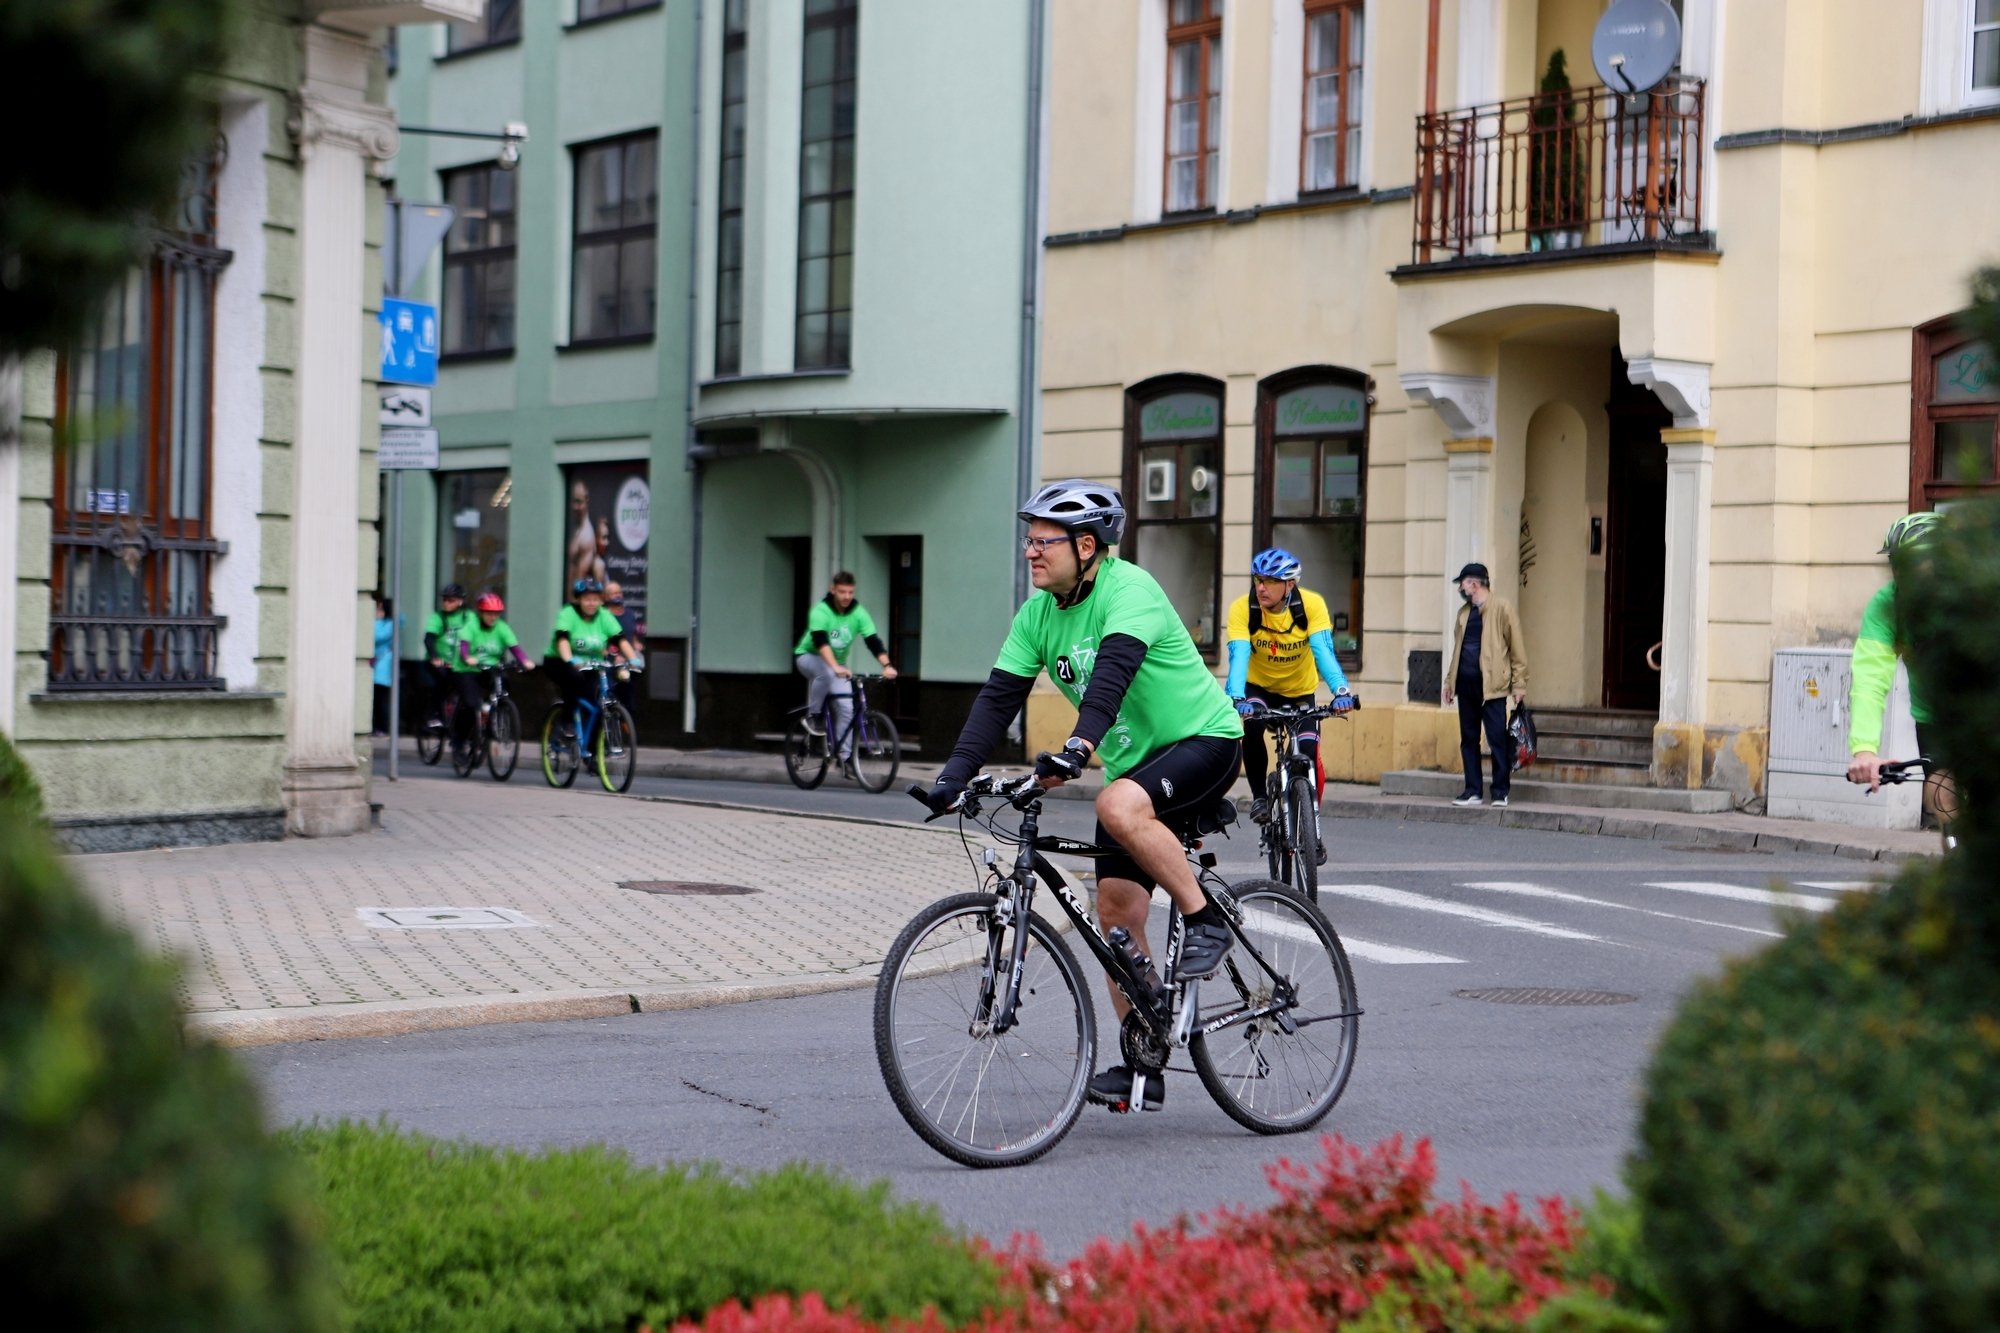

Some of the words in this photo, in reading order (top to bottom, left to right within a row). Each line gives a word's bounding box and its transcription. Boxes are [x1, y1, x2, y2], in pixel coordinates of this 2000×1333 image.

[1256, 639, 1307, 651] ORGANIZATO
[1267, 654, 1302, 663] PARADY
[1057, 660, 1072, 679] 21
